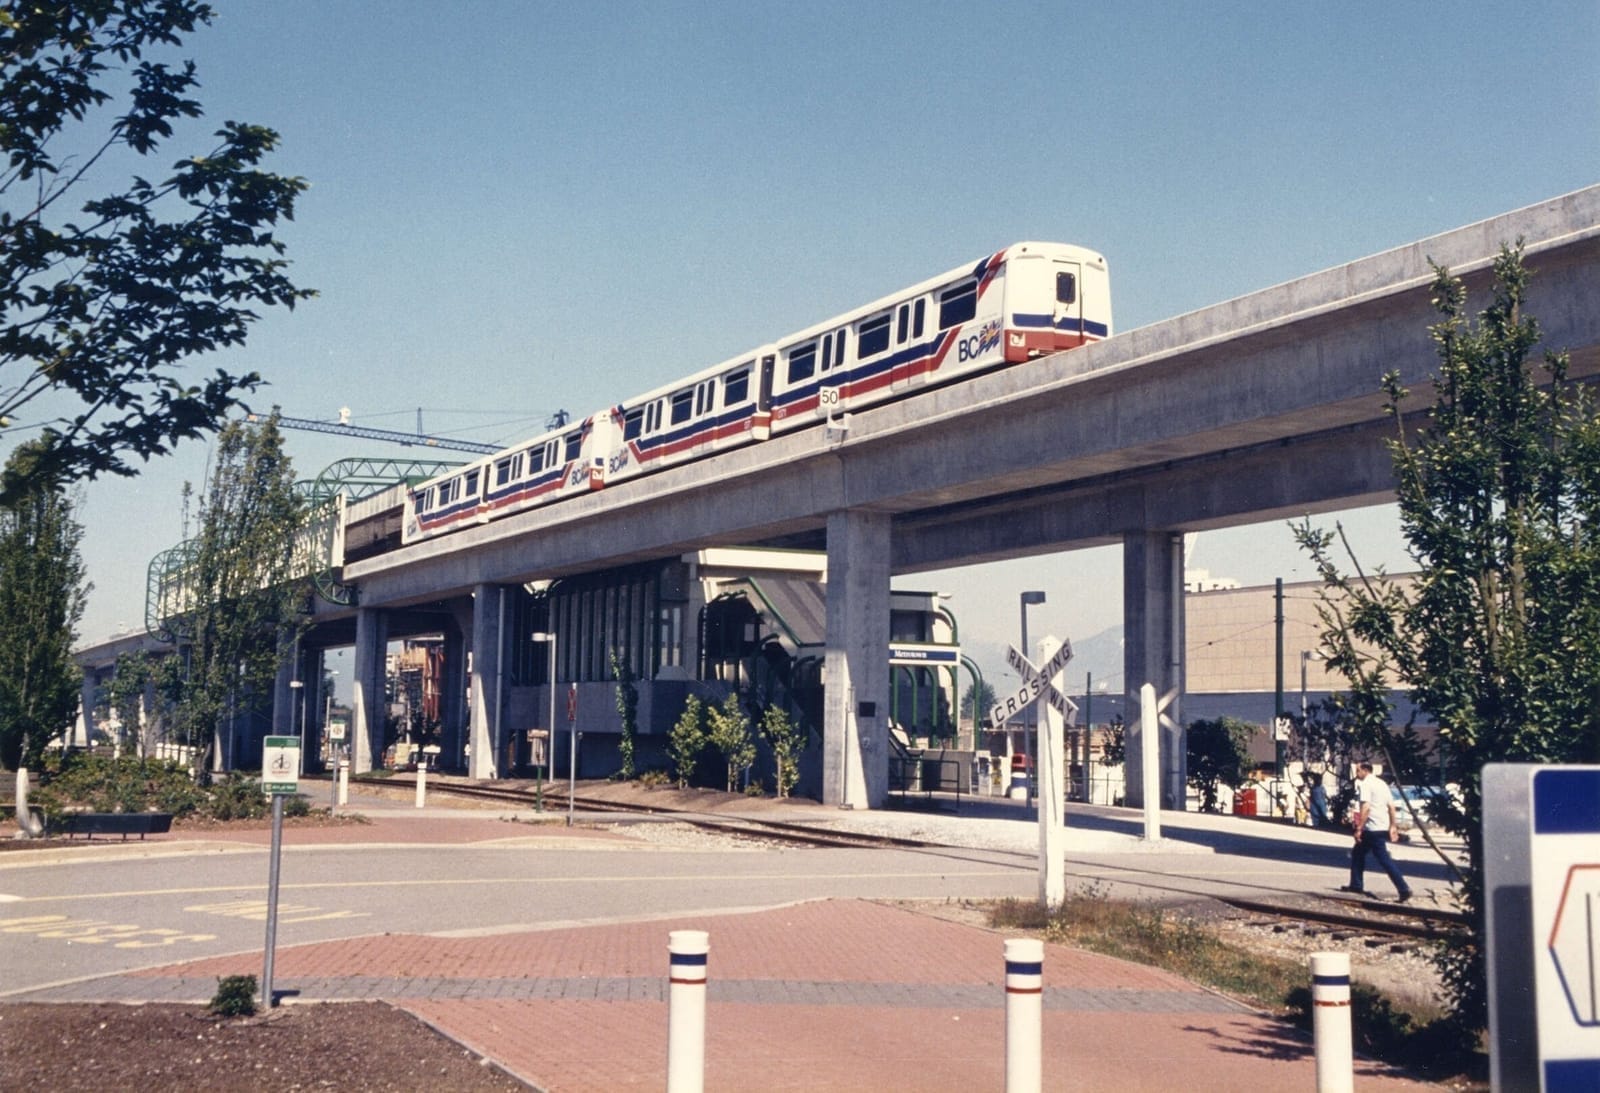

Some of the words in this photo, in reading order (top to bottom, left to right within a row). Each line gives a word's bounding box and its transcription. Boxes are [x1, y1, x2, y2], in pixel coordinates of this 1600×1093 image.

[958, 337, 979, 363] BC
[822, 390, 838, 405] 50
[994, 643, 1071, 722] CROSSING
[1008, 649, 1031, 681] RAIL
[1050, 687, 1074, 720] WAY
